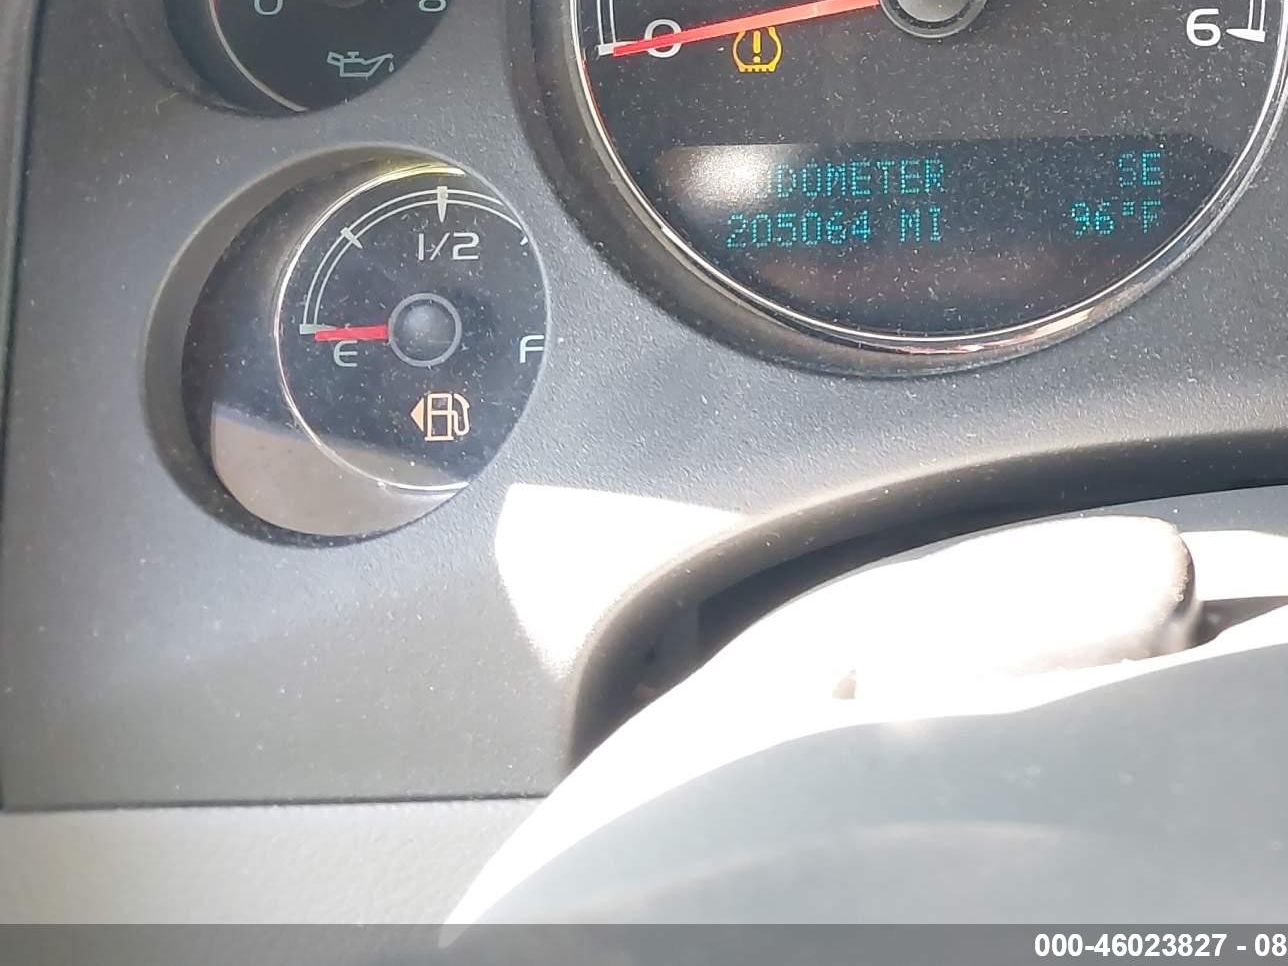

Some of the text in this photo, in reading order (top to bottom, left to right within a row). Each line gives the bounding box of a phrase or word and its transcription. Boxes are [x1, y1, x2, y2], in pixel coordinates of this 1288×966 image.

[644, 19, 683, 58] 0
[1186, 8, 1221, 47] 6
[1119, 152, 1161, 186] SE
[726, 206, 943, 250] 205064 MI
[417, 231, 481, 262] 1/2
[332, 338, 359, 368] E
[519, 333, 545, 364] F
